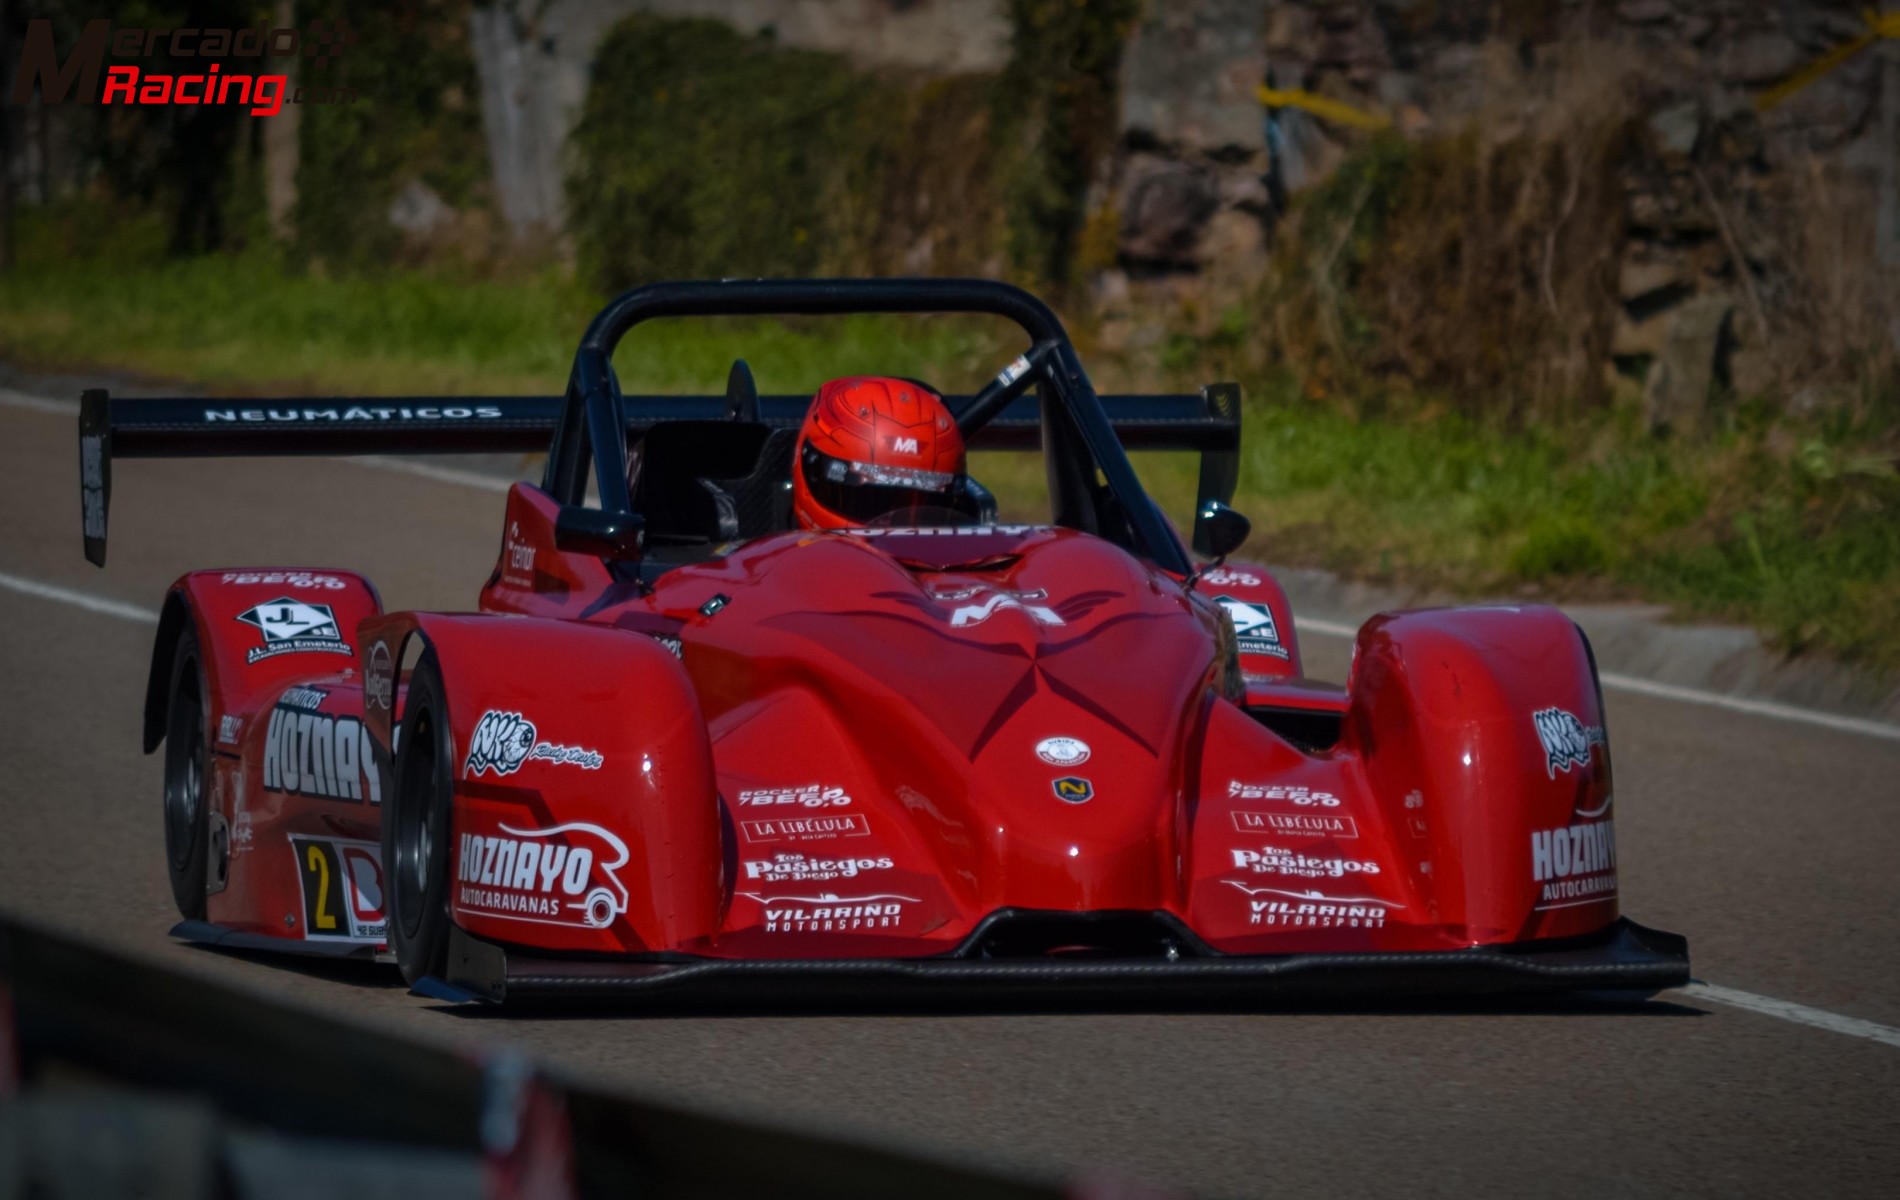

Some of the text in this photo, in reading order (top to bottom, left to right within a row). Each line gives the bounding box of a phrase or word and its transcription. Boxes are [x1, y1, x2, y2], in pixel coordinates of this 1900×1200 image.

[204, 406, 502, 421] NEUMÁTICOS
[268, 641, 293, 651] San
[294, 640, 351, 651] Emeterio
[1237, 641, 1288, 654] meterio
[740, 785, 820, 799] ROCKER
[755, 818, 856, 836] LA LIBÉLULA
[1244, 813, 1344, 831] LA LIBÉLULA
[458, 832, 593, 895] HOZNAYO
[744, 858, 895, 880] Pasiegos
[1231, 849, 1381, 878] Pasiegos
[1253, 864, 1325, 878] De Diego
[766, 870, 839, 882] De Diego
[307, 844, 337, 929] 2
[460, 885, 560, 916] AUTOCARAVANAS
[766, 915, 902, 932] MOTORSPORT
[1251, 913, 1386, 928] MOTORSPORT
